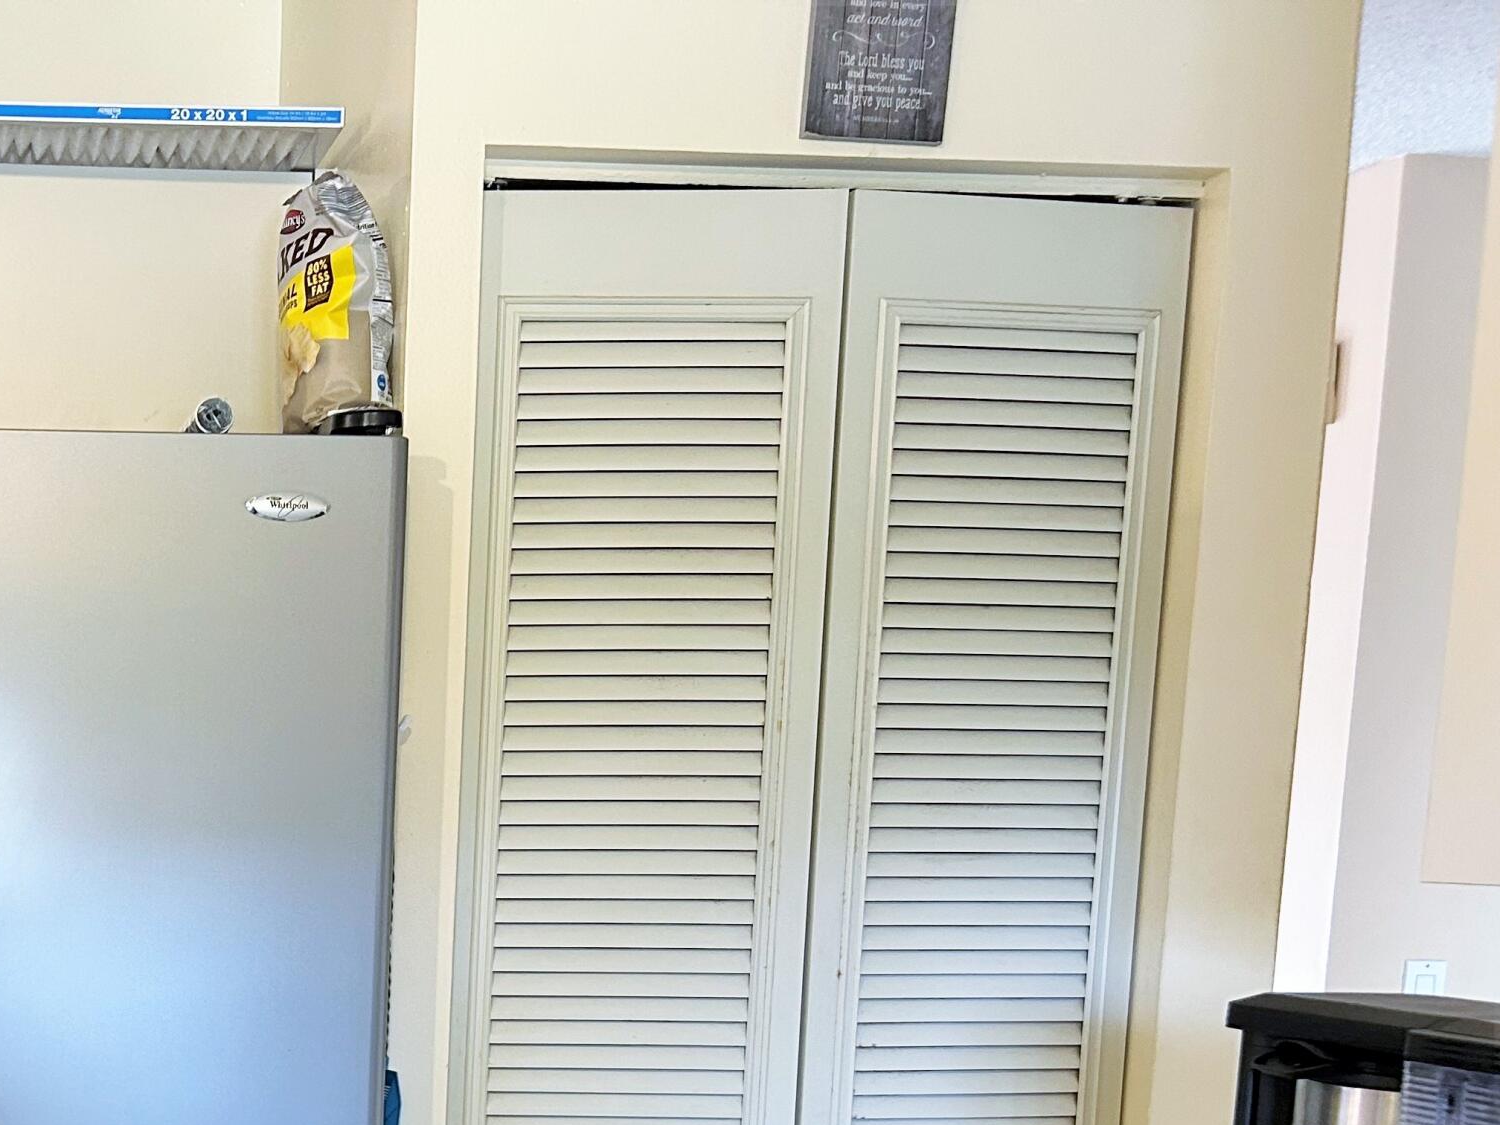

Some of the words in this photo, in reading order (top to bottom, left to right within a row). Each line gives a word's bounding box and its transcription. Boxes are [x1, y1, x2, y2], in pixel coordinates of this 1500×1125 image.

[846, 12, 865, 24] act
[867, 13, 891, 26] and
[891, 15, 924, 28] word
[839, 50, 856, 67] The
[858, 52, 878, 68] Lord
[881, 53, 905, 70] bless
[908, 58, 925, 73] you
[847, 68, 865, 79] and
[866, 69, 888, 82] keep
[825, 80, 843, 91] and
[898, 84, 907, 94] to
[832, 92, 850, 106] and
[851, 94, 873, 110] give
[874, 97, 893, 111] you
[170, 108, 190, 121] 20
[193, 112, 203, 121] x
[205, 108, 225, 121] 20
[227, 112, 237, 121] x
[240, 109, 248, 122] 1
[307, 258, 329, 276] 80%
[306, 271, 331, 286] LESS
[311, 282, 329, 297] FAT
[269, 499, 309, 511] Whirlpool
